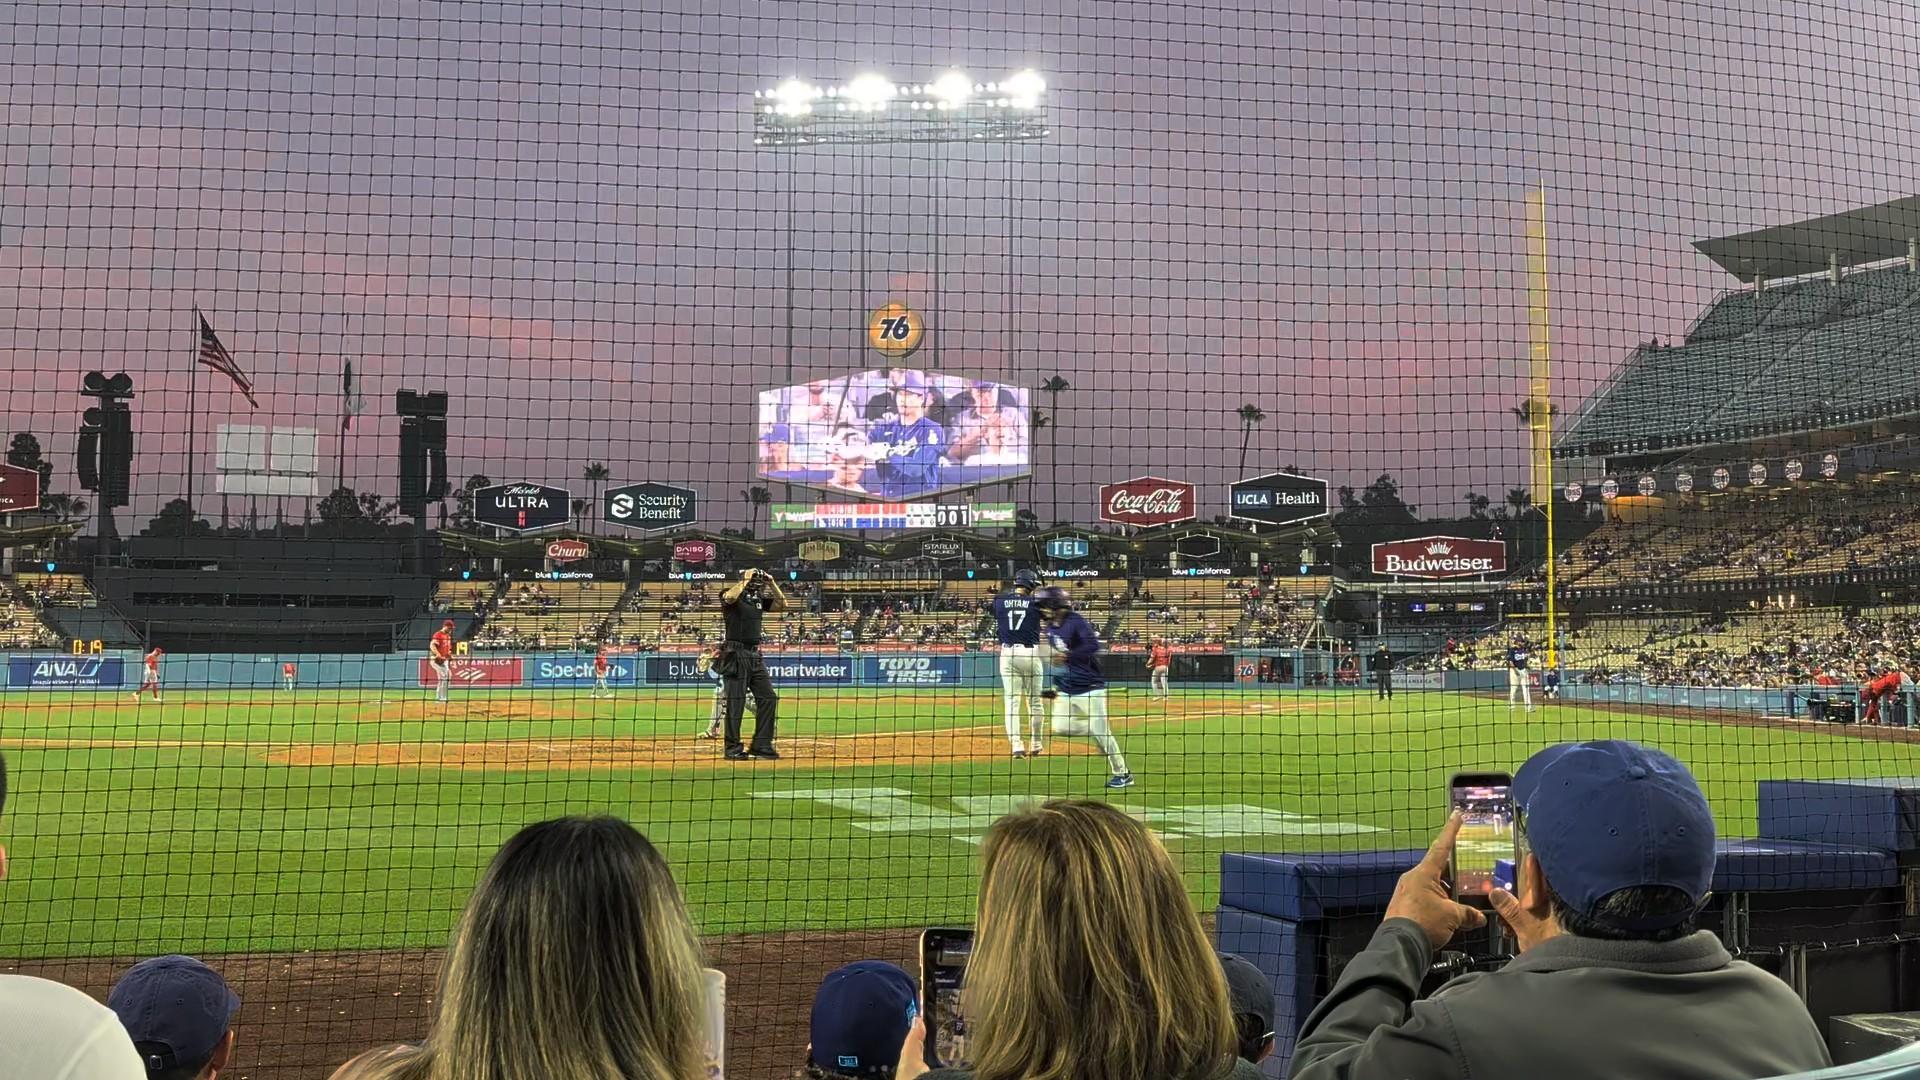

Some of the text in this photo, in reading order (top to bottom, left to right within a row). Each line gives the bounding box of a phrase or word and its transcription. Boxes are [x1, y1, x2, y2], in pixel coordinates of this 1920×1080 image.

[879, 313, 911, 341] 76
[495, 496, 549, 508] ULTRA
[639, 494, 688, 508] Security
[1109, 489, 1186, 514] Coca-Cola
[1237, 492, 1320, 505] UCLA Health
[640, 507, 681, 518] Benefit
[548, 544, 586, 557] Churu
[535, 571, 594, 579] blue california
[1196, 567, 1231, 575] california
[1003, 600, 1030, 609] OHTANI
[1007, 610, 1026, 631] 17
[73, 639, 103, 655] 0:19
[33, 661, 77, 677] ANA
[766, 663, 847, 678] martwater
[878, 658, 930, 670] TOYO
[540, 662, 618, 681] Spectrm
[886, 670, 943, 683] TIRES
